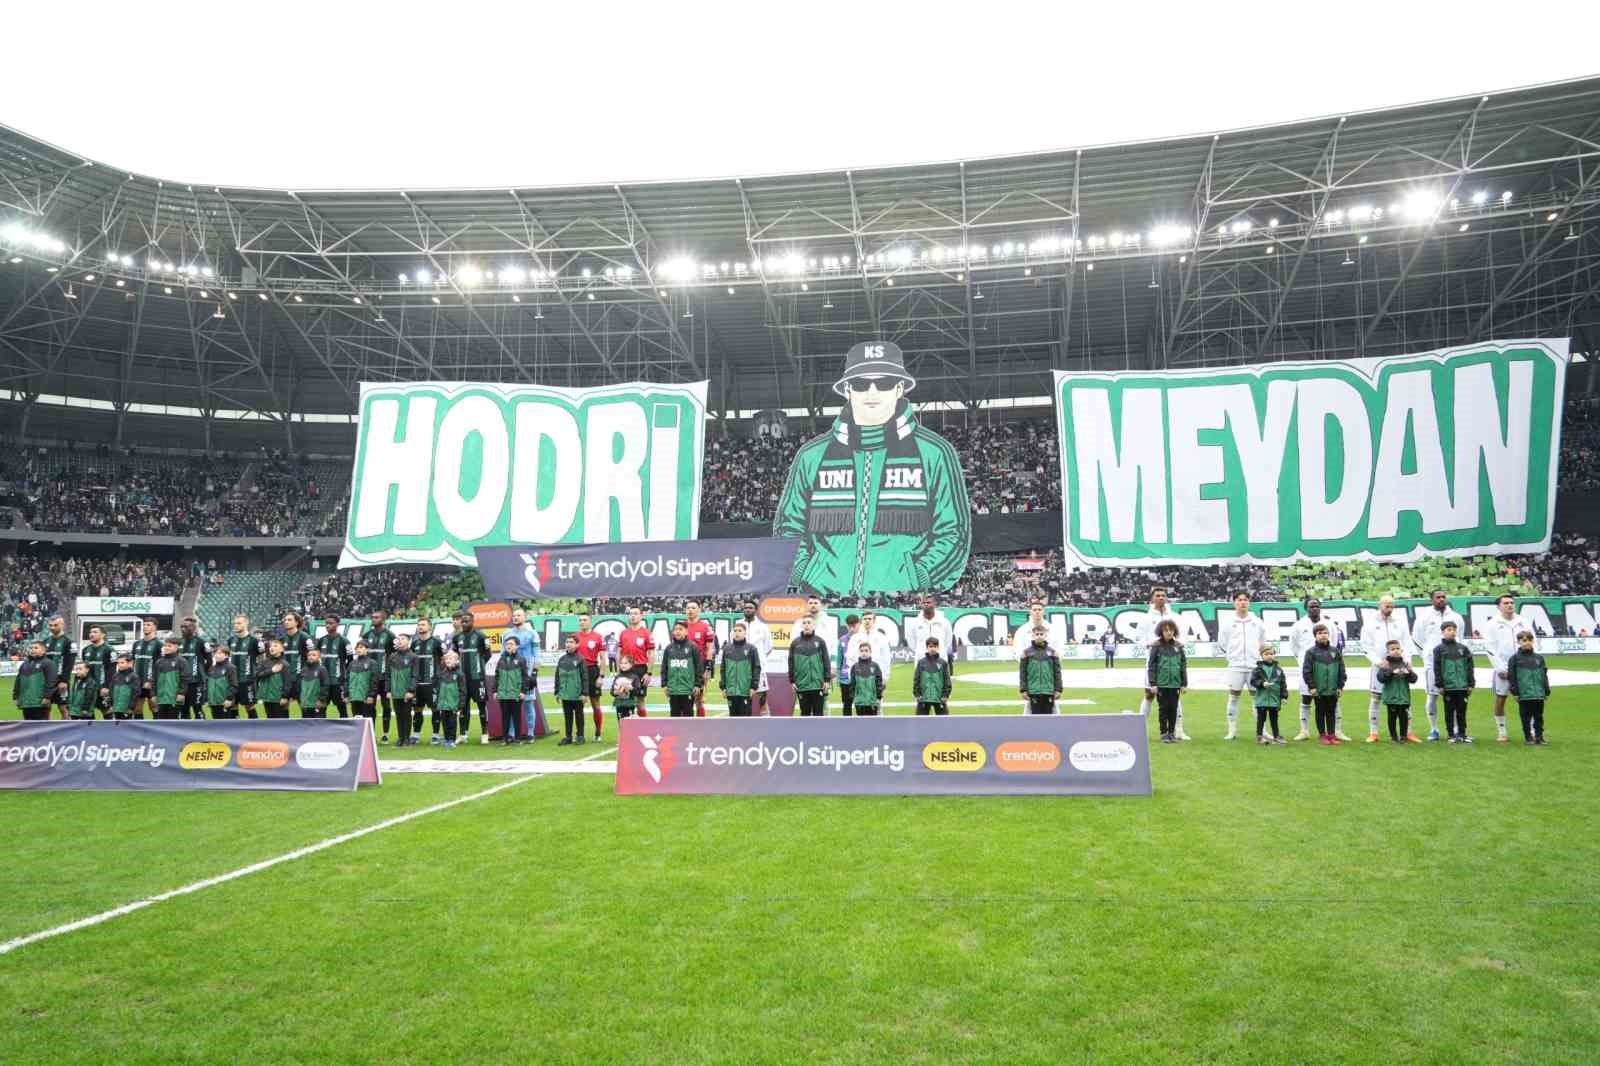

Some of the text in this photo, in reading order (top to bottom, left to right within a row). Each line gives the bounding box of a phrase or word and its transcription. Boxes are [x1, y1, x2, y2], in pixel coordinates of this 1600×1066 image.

[864, 345, 885, 359] KS
[1071, 359, 1534, 545] MEYDAN
[818, 467, 923, 489] UNI HM
[555, 555, 663, 582] trendyol
[0, 740, 87, 767] rendyol
[185, 747, 225, 762] NESİNE
[241, 749, 285, 762] trendyol
[685, 741, 804, 771] trendyol
[930, 747, 978, 763] NESİNE
[1001, 749, 1056, 764] trendyol
